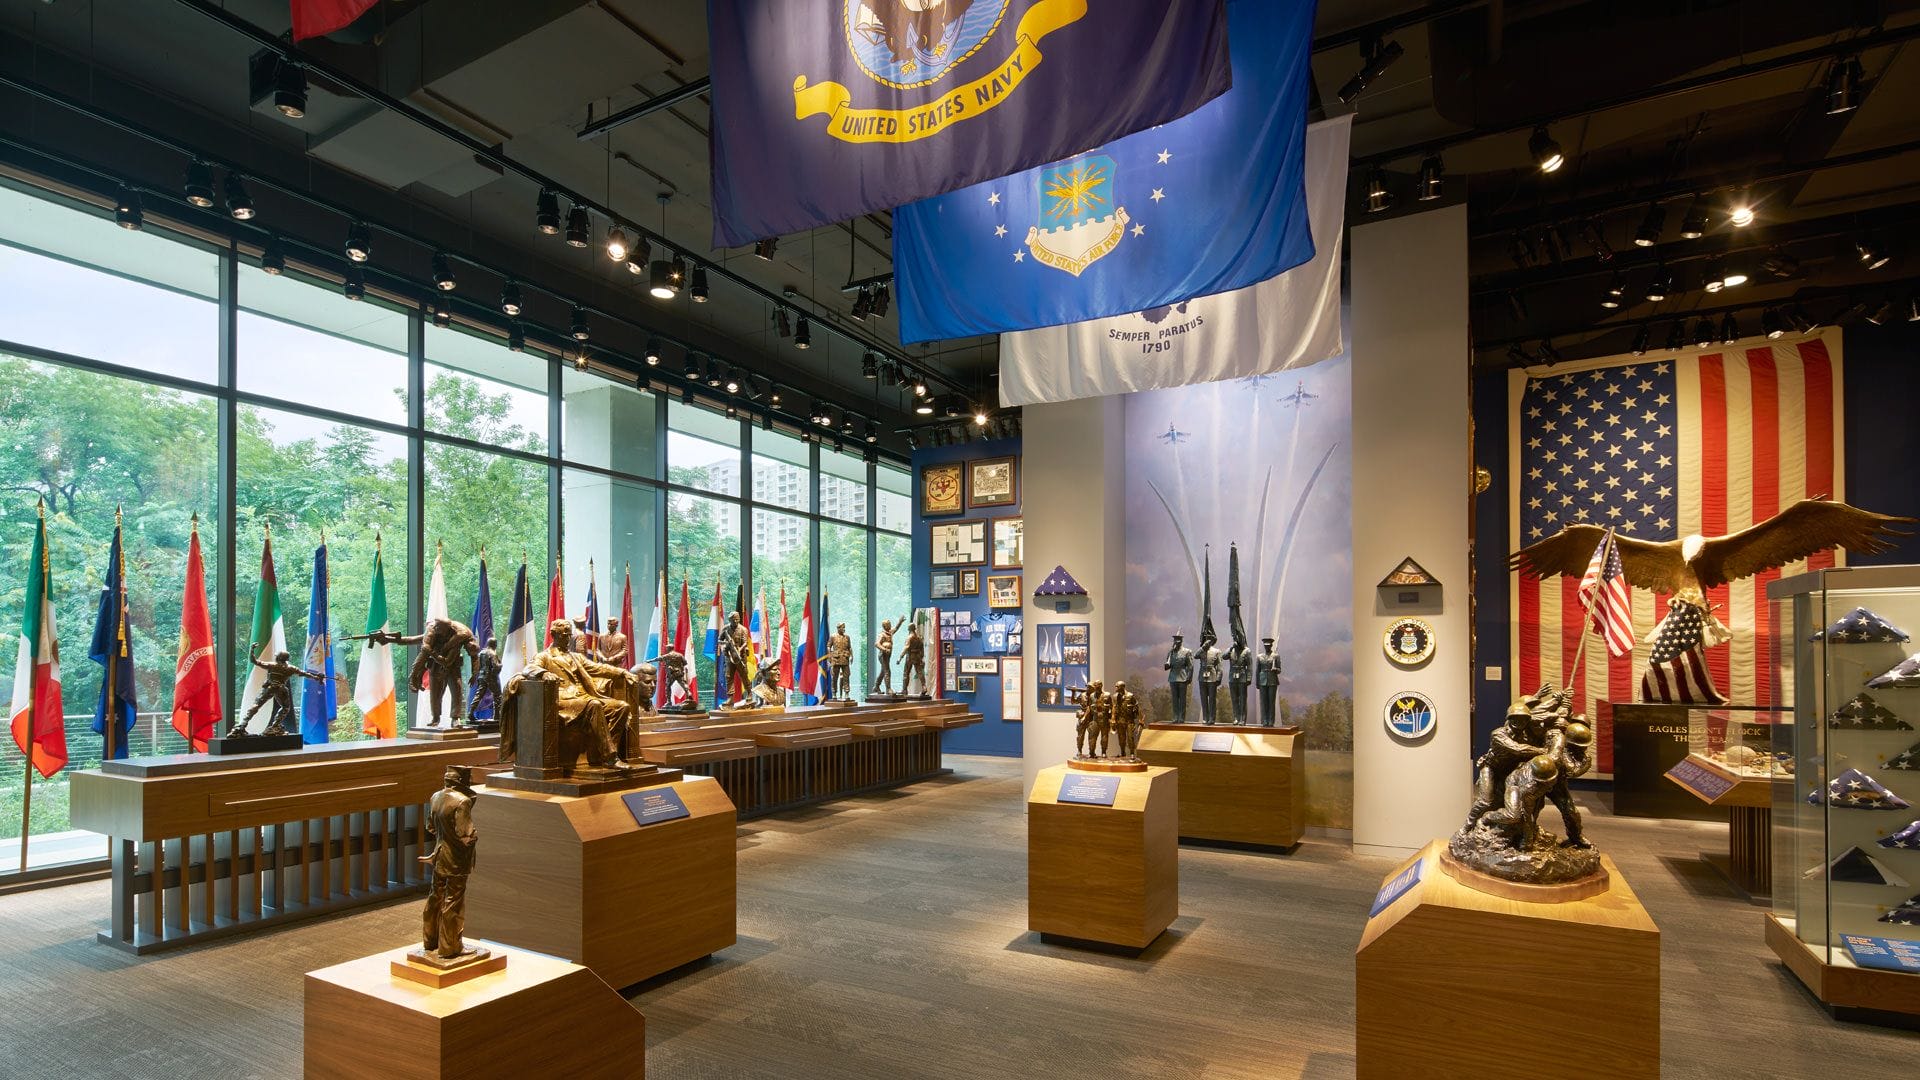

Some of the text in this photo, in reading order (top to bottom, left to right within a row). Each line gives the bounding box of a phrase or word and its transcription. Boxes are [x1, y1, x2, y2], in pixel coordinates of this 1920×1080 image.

[841, 55, 1024, 136] UNITED STATES NAVY
[1031, 240, 1054, 264] UNITED
[1055, 256, 1088, 273] STATES
[1089, 245, 1104, 261] AIR
[1109, 315, 1204, 342] SEMPER PARATUS
[1142, 340, 1171, 354] 1790
[988, 633, 1003, 648] 43
[1648, 725, 1688, 734] EAGLES
[1727, 727, 1761, 736] FLOCK
